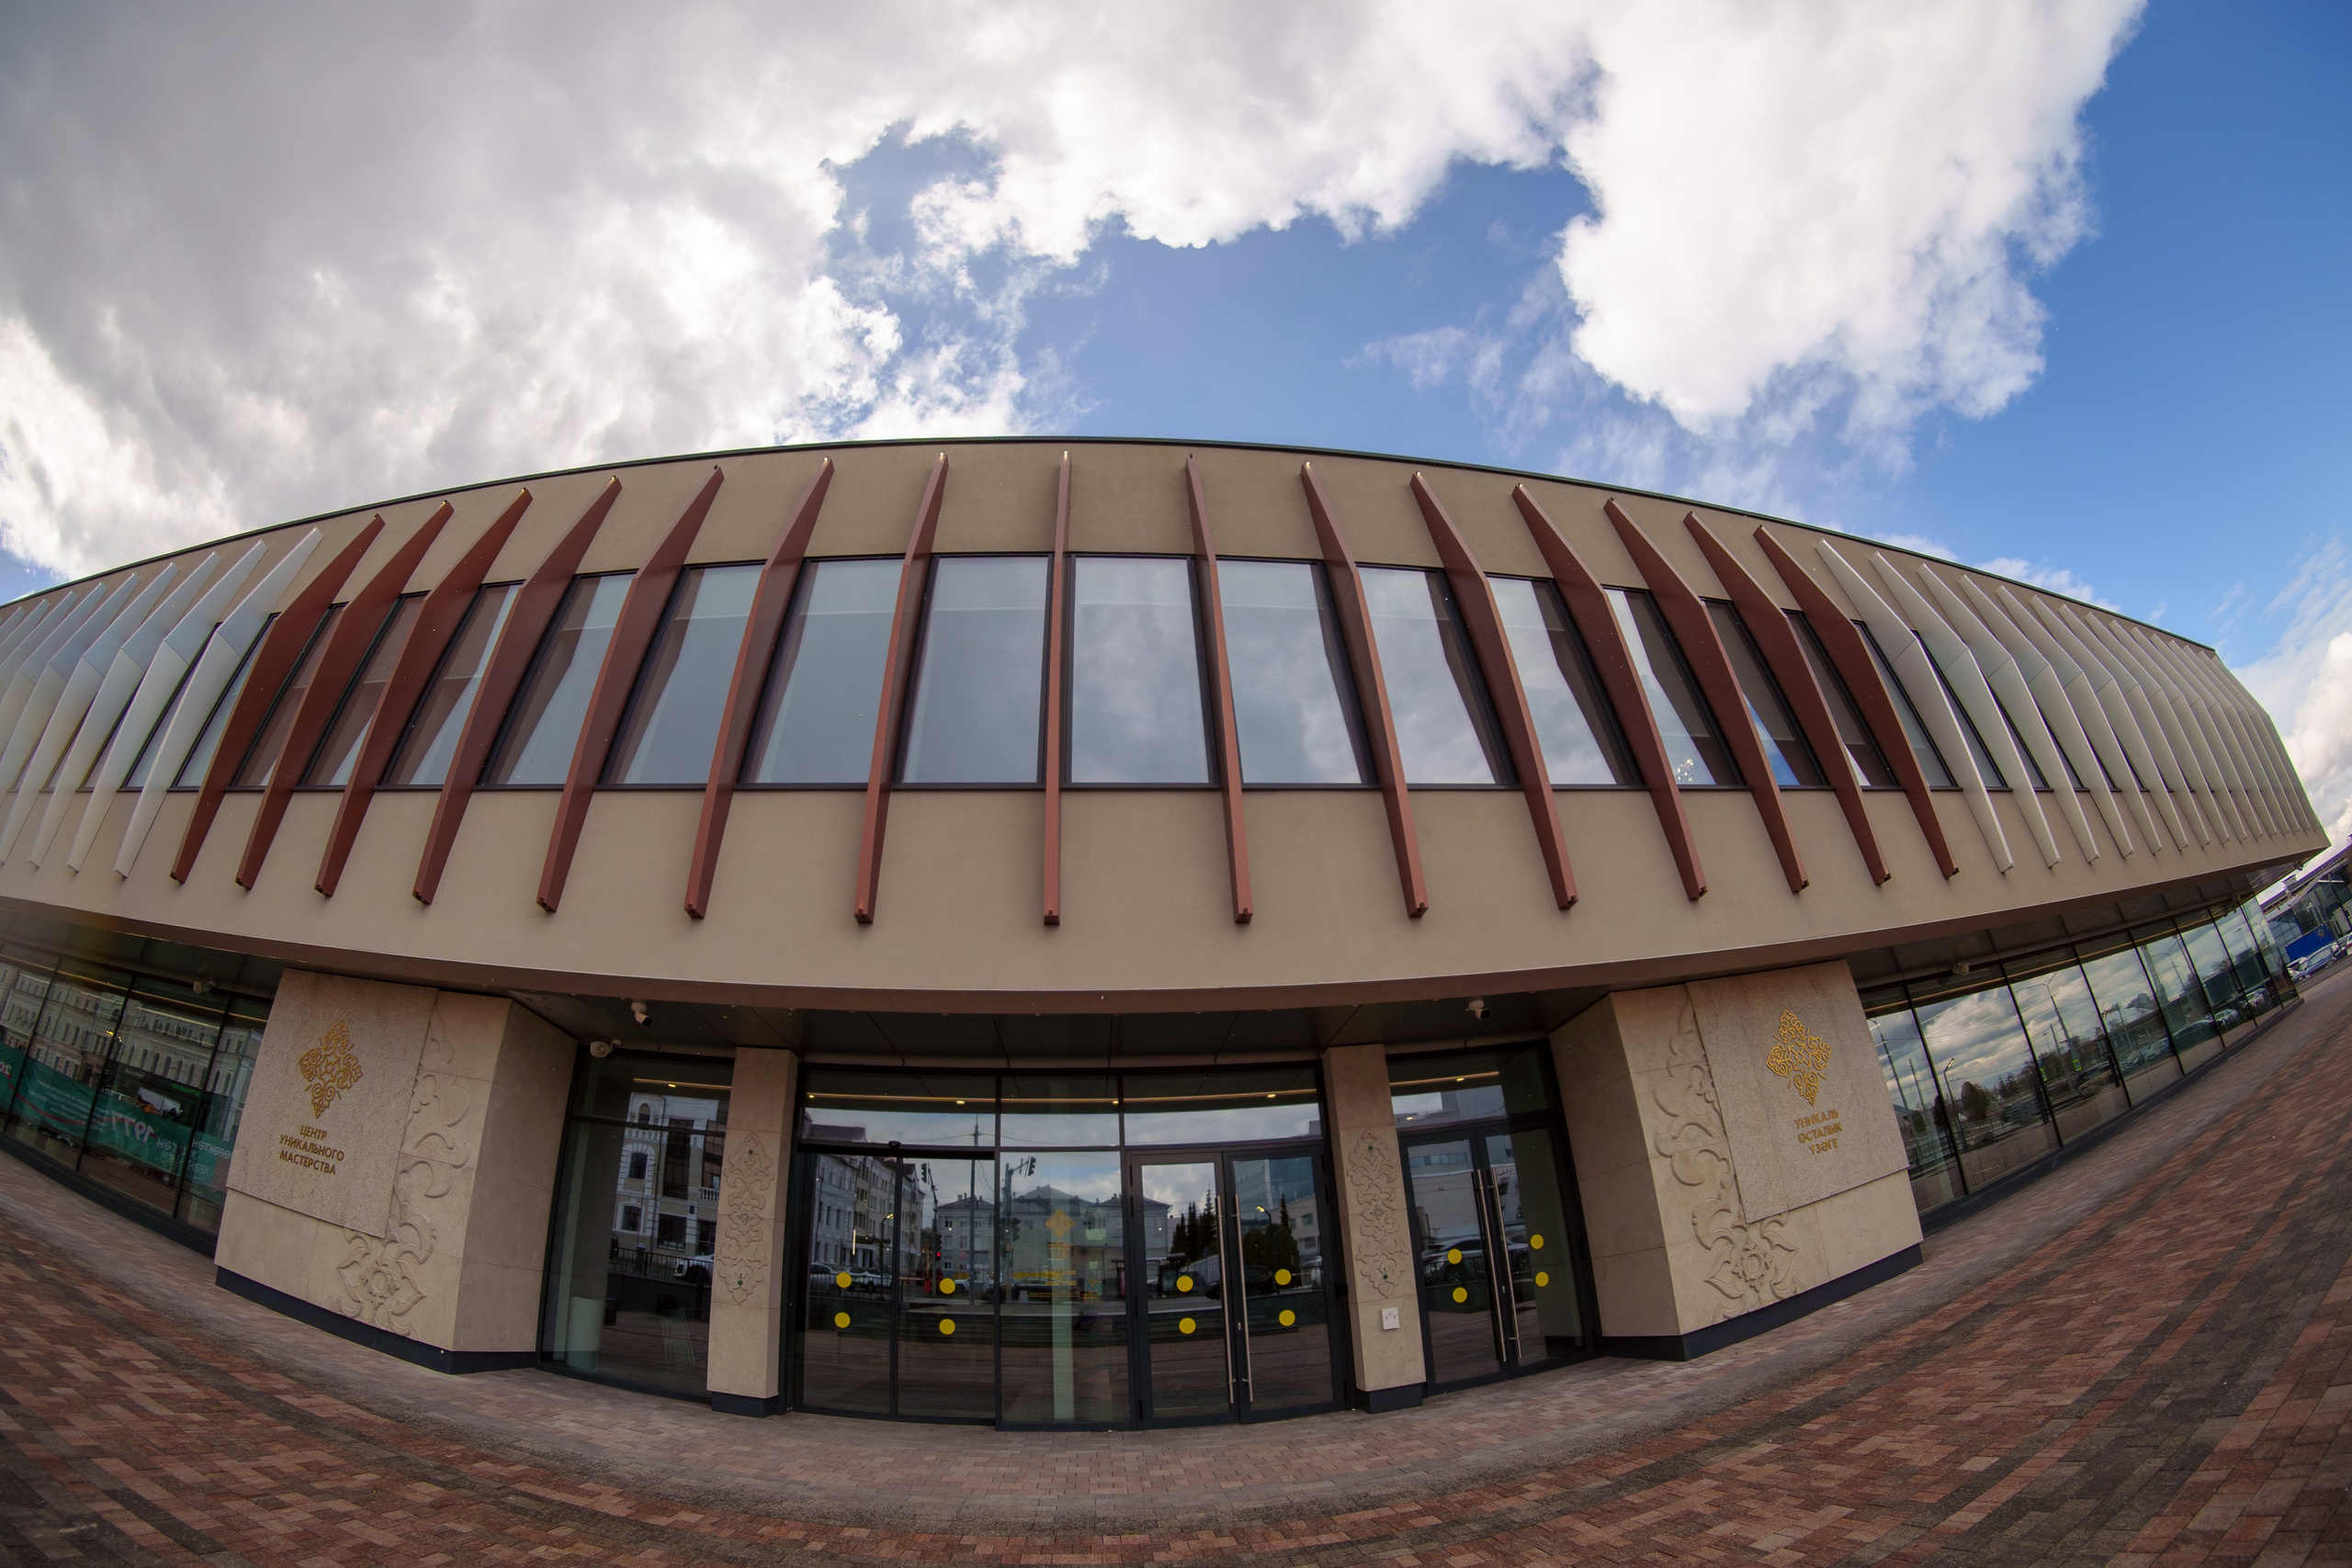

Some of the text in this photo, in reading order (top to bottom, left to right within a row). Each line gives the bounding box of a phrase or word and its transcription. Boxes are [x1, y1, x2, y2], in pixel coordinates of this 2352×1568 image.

[1793, 1108, 1839, 1130] УНИКАЛЬ
[300, 1124, 328, 1141] ЦЕНТР
[1797, 1121, 1843, 1144] ОСТАЛЫК
[279, 1134, 345, 1161] УНИКАЛЬНОГО
[279, 1149, 336, 1176] МАСТЕРСТВА
